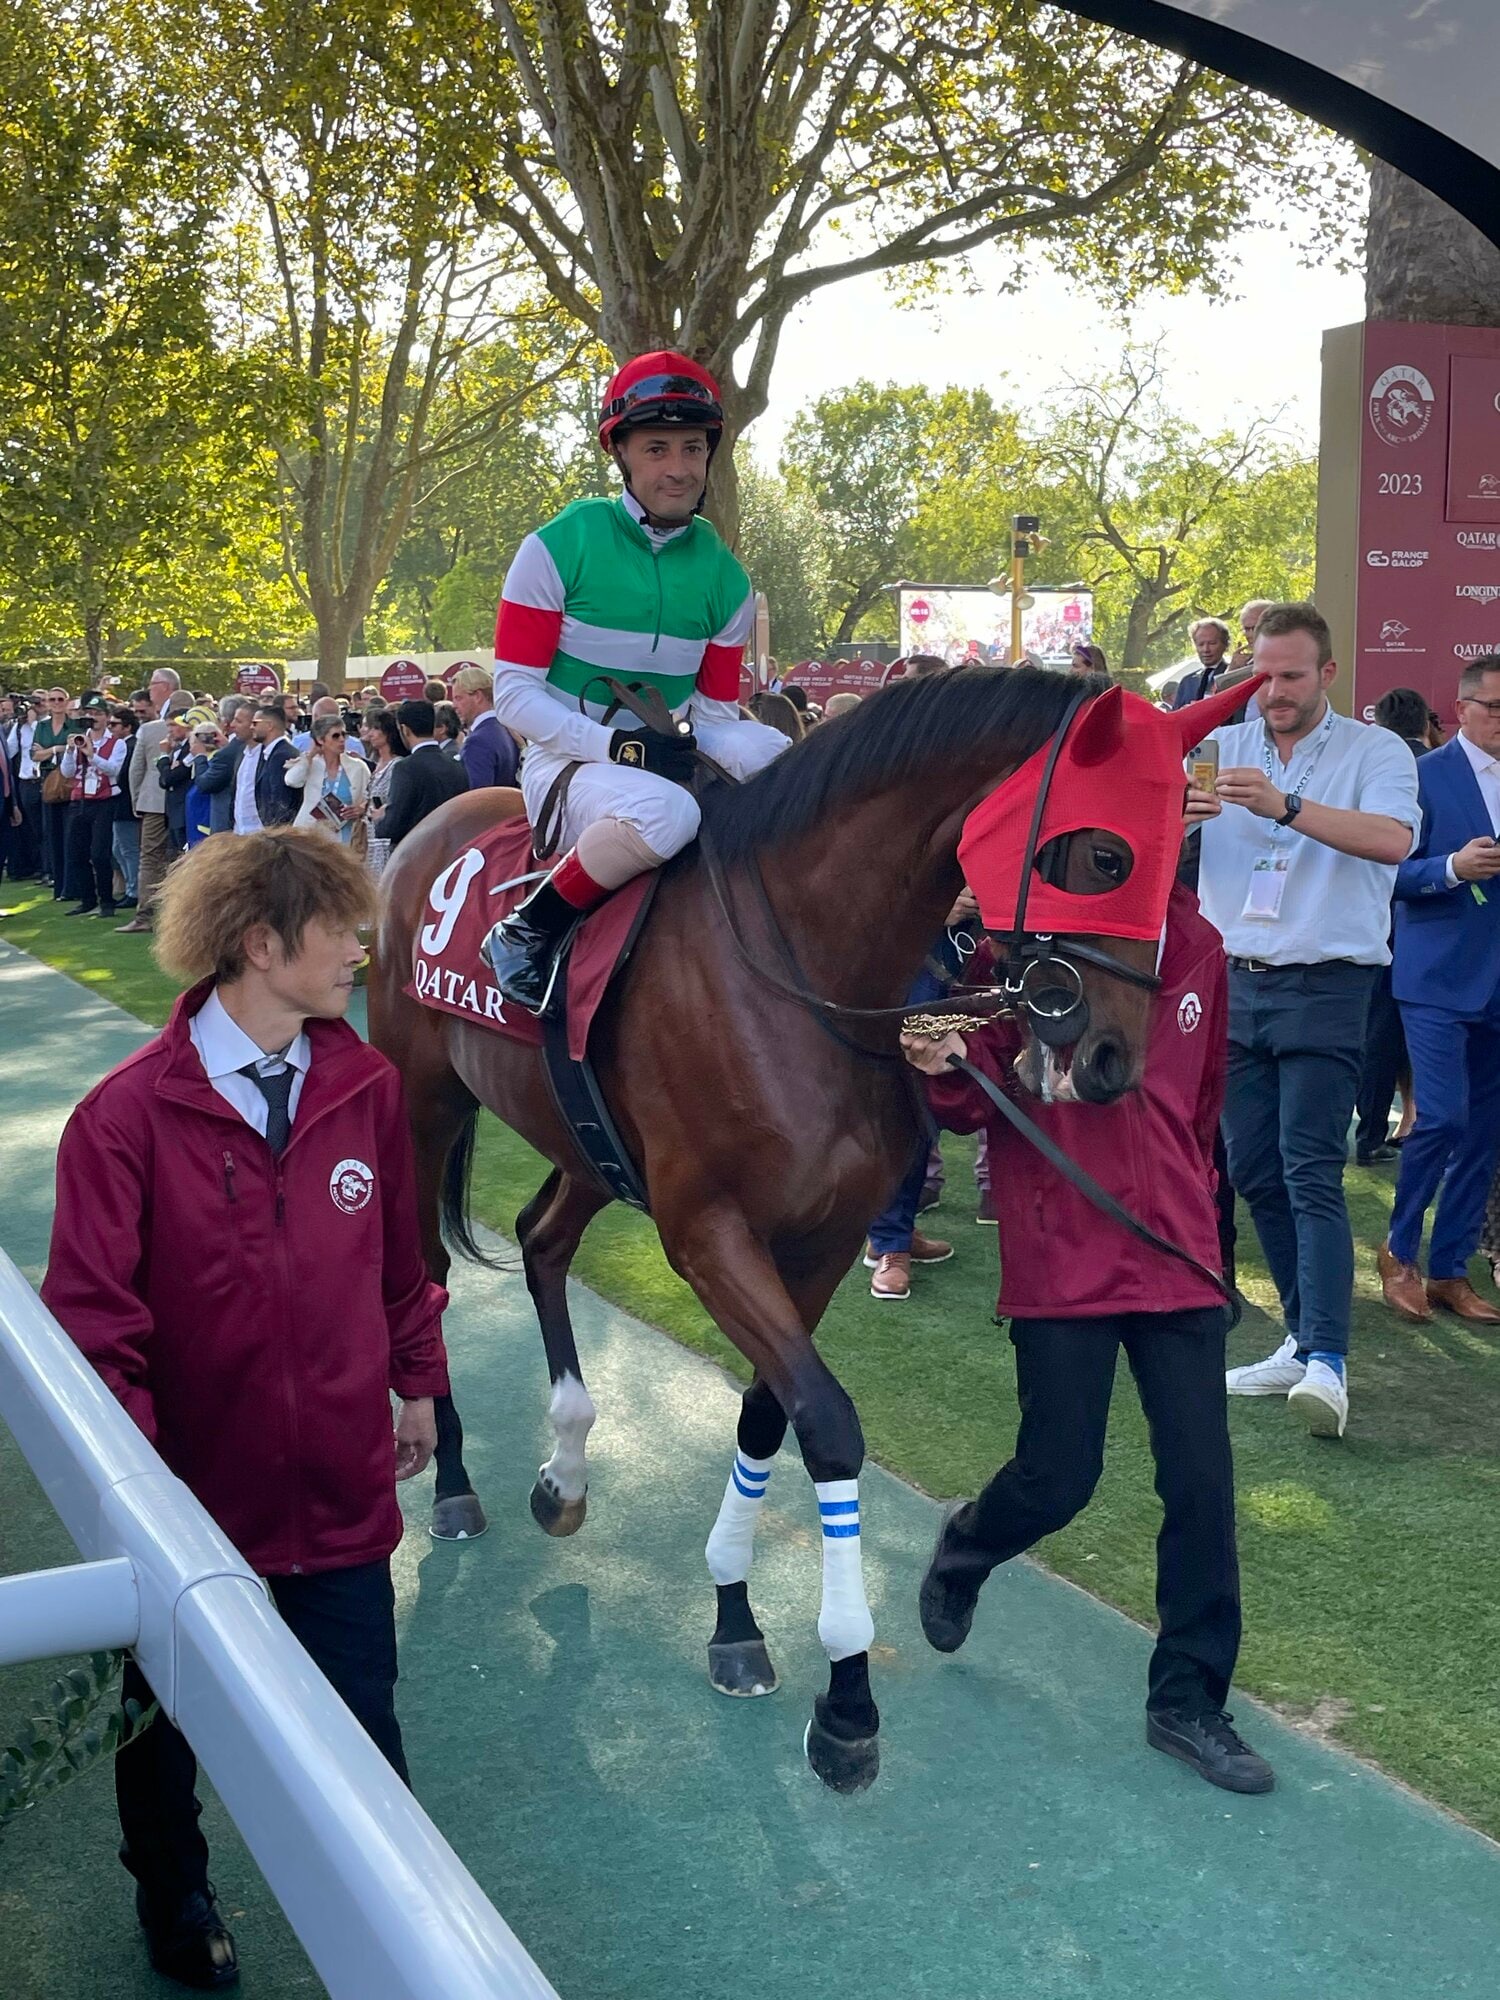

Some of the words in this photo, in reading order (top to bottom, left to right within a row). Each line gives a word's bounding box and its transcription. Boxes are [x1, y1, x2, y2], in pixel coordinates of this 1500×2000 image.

[1380, 367, 1426, 388] QATAR
[1378, 473, 1423, 495] 2023
[1456, 531, 1496, 546] QATAR
[1391, 550, 1429, 559] FRANCE
[1391, 559, 1423, 568] GALOP
[1453, 643, 1493, 659] QATAR
[1293, 776, 1308, 796] LIVE
[420, 848, 485, 956] 9
[415, 959, 507, 1024] QATAR
[334, 1161, 365, 1176] QATAR
